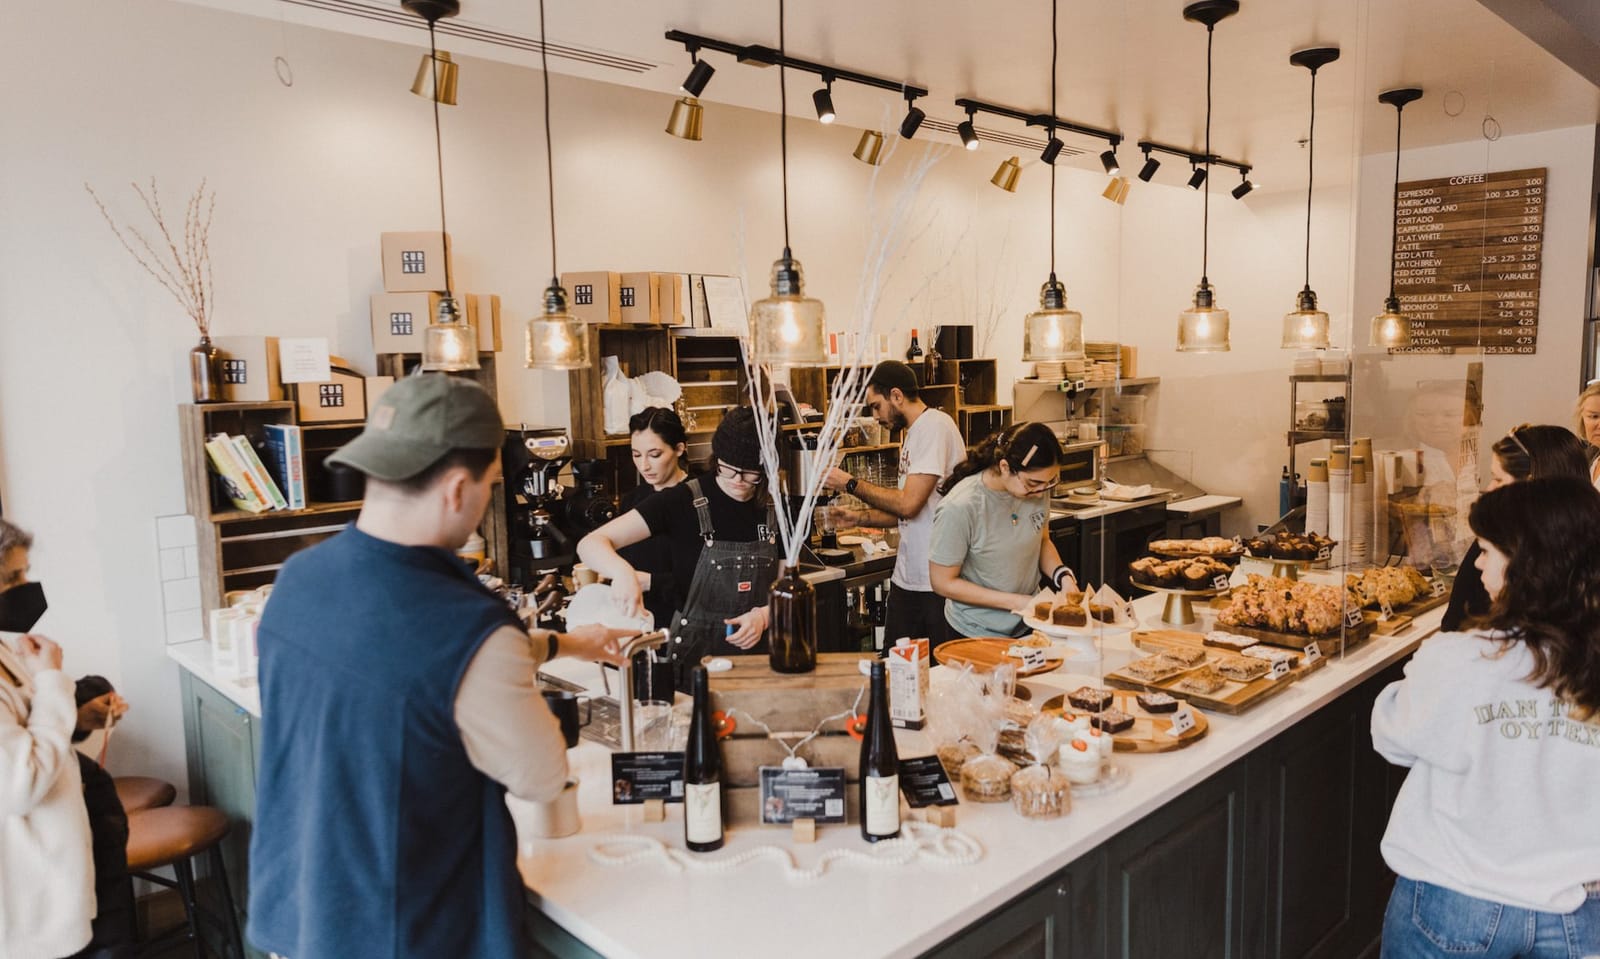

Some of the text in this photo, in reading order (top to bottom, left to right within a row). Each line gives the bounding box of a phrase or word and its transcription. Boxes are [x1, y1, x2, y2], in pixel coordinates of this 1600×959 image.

[1450, 174, 1484, 185] COFFEE
[1399, 189, 1434, 198] ESPRESSO
[1398, 197, 1441, 206] AMERICANO
[1412, 204, 1458, 214] AMERICANO
[1397, 216, 1434, 224] CORTADO
[1397, 224, 1444, 234] CAPPUCCINO
[1418, 232, 1440, 240] WHITE
[1397, 243, 1420, 251] LATTE
[403, 252, 424, 261] CUR
[1411, 250, 1434, 258] LATTE
[404, 263, 424, 272] ATE
[1452, 284, 1471, 292] TEA
[576, 296, 592, 304] ATE
[391, 314, 412, 322] CUR
[392, 325, 412, 334] ATE
[1426, 328, 1450, 336] LATTE
[320, 385, 342, 394] CUR
[322, 396, 342, 406] ATE
